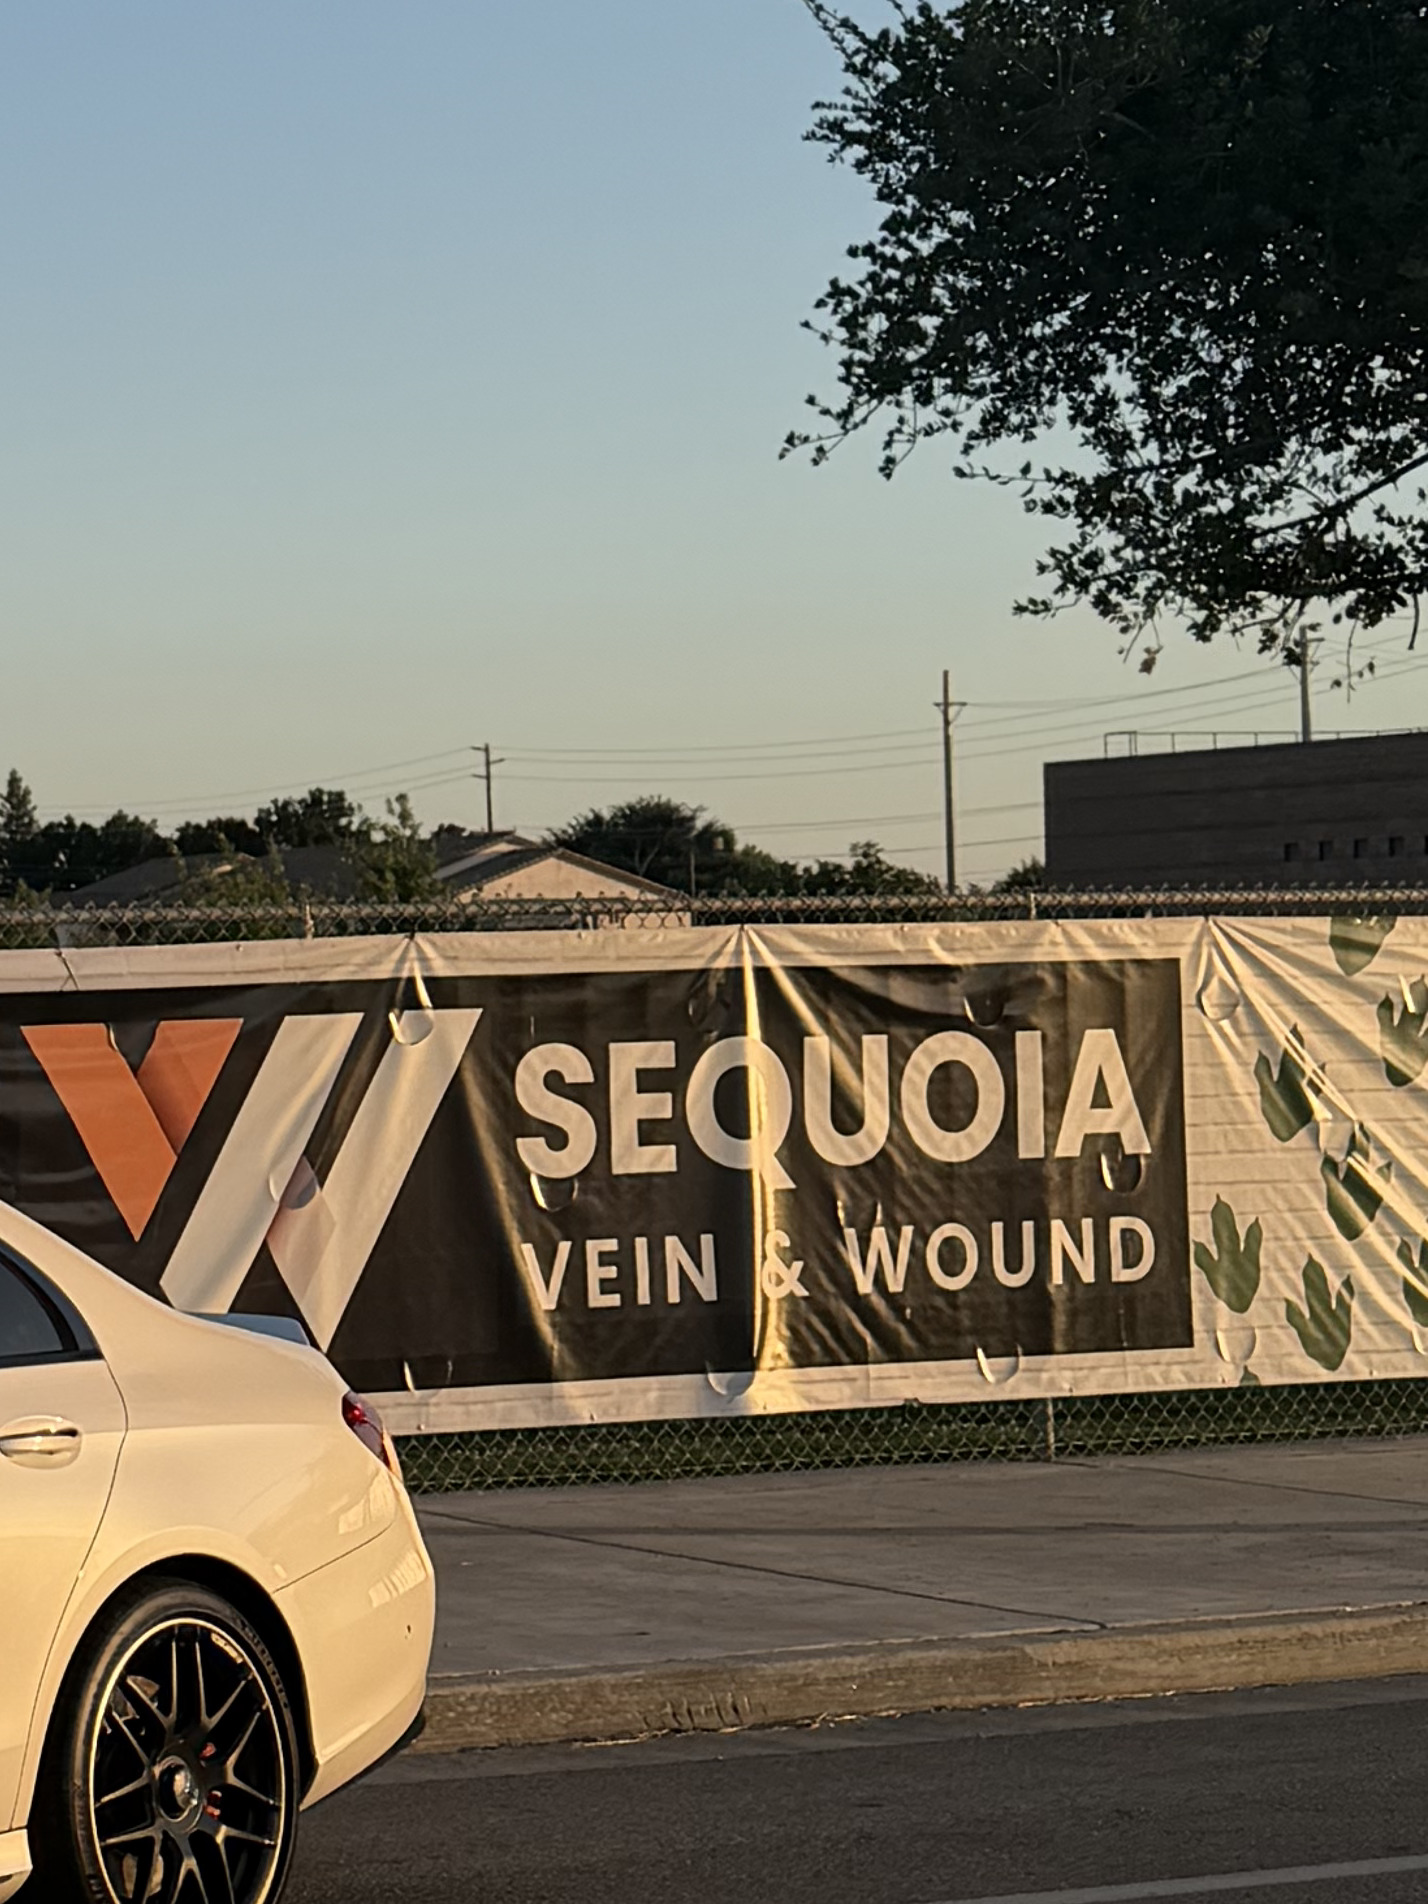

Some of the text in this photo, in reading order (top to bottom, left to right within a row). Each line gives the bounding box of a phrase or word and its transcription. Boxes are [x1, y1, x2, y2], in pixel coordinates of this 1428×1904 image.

[515, 1028, 1152, 1190] SEQUOIA
[521, 1216, 1156, 1310] VEIN & WOUND
